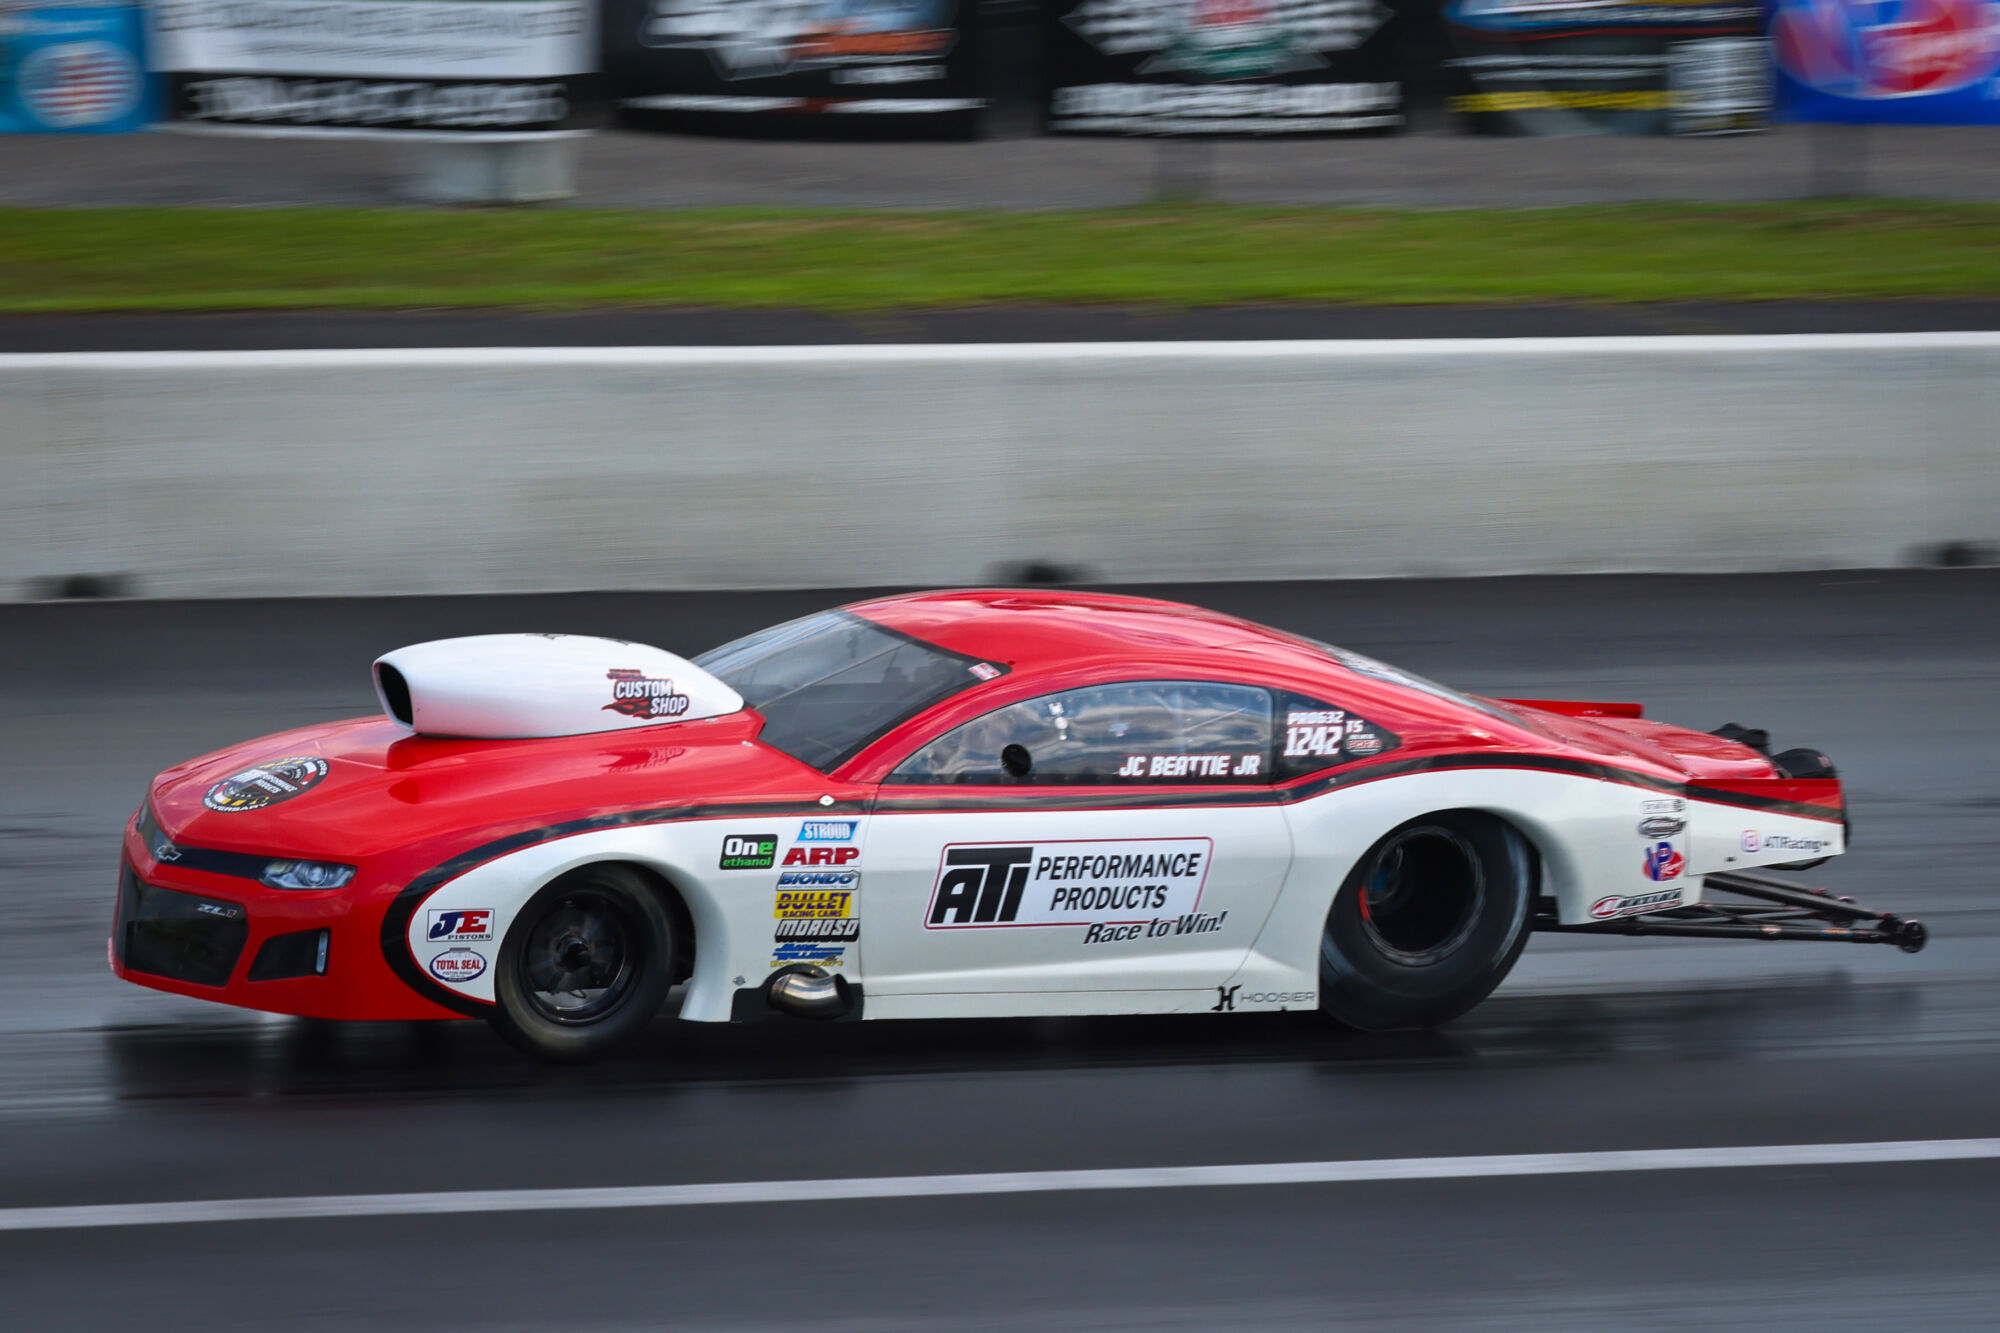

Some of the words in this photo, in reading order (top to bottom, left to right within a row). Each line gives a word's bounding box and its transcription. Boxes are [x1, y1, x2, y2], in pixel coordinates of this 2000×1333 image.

[616, 681, 671, 698] CUSTOM
[651, 697, 687, 714] SHOP
[1287, 711, 1345, 726] PRO632
[1283, 726, 1344, 757] 1242
[1345, 720, 1364, 733] TS
[1119, 756, 1147, 776] JC
[1149, 755, 1231, 776] BEATTIE
[1233, 755, 1261, 775] JR
[804, 823, 850, 839] STROUD
[725, 839, 774, 855] One
[722, 858, 771, 866] ethanol
[782, 848, 859, 865] ARP
[779, 873, 854, 885] BIONDO
[929, 846, 1034, 924] ATI
[1034, 852, 1203, 881] PERFORMANCE
[777, 893, 851, 909] BULLET
[1049, 884, 1168, 911] PRODUCTS
[782, 910, 815, 918] RACING
[429, 911, 489, 939] JE
[776, 919, 860, 937] MOROSO
[1082, 923, 1146, 945] Race
[1149, 917, 1170, 938] to
[1174, 910, 1228, 935] Win!
[436, 960, 459, 970] TOTAL
[461, 960, 481, 969] SEAL
[1240, 991, 1317, 1002] HOOSIER
